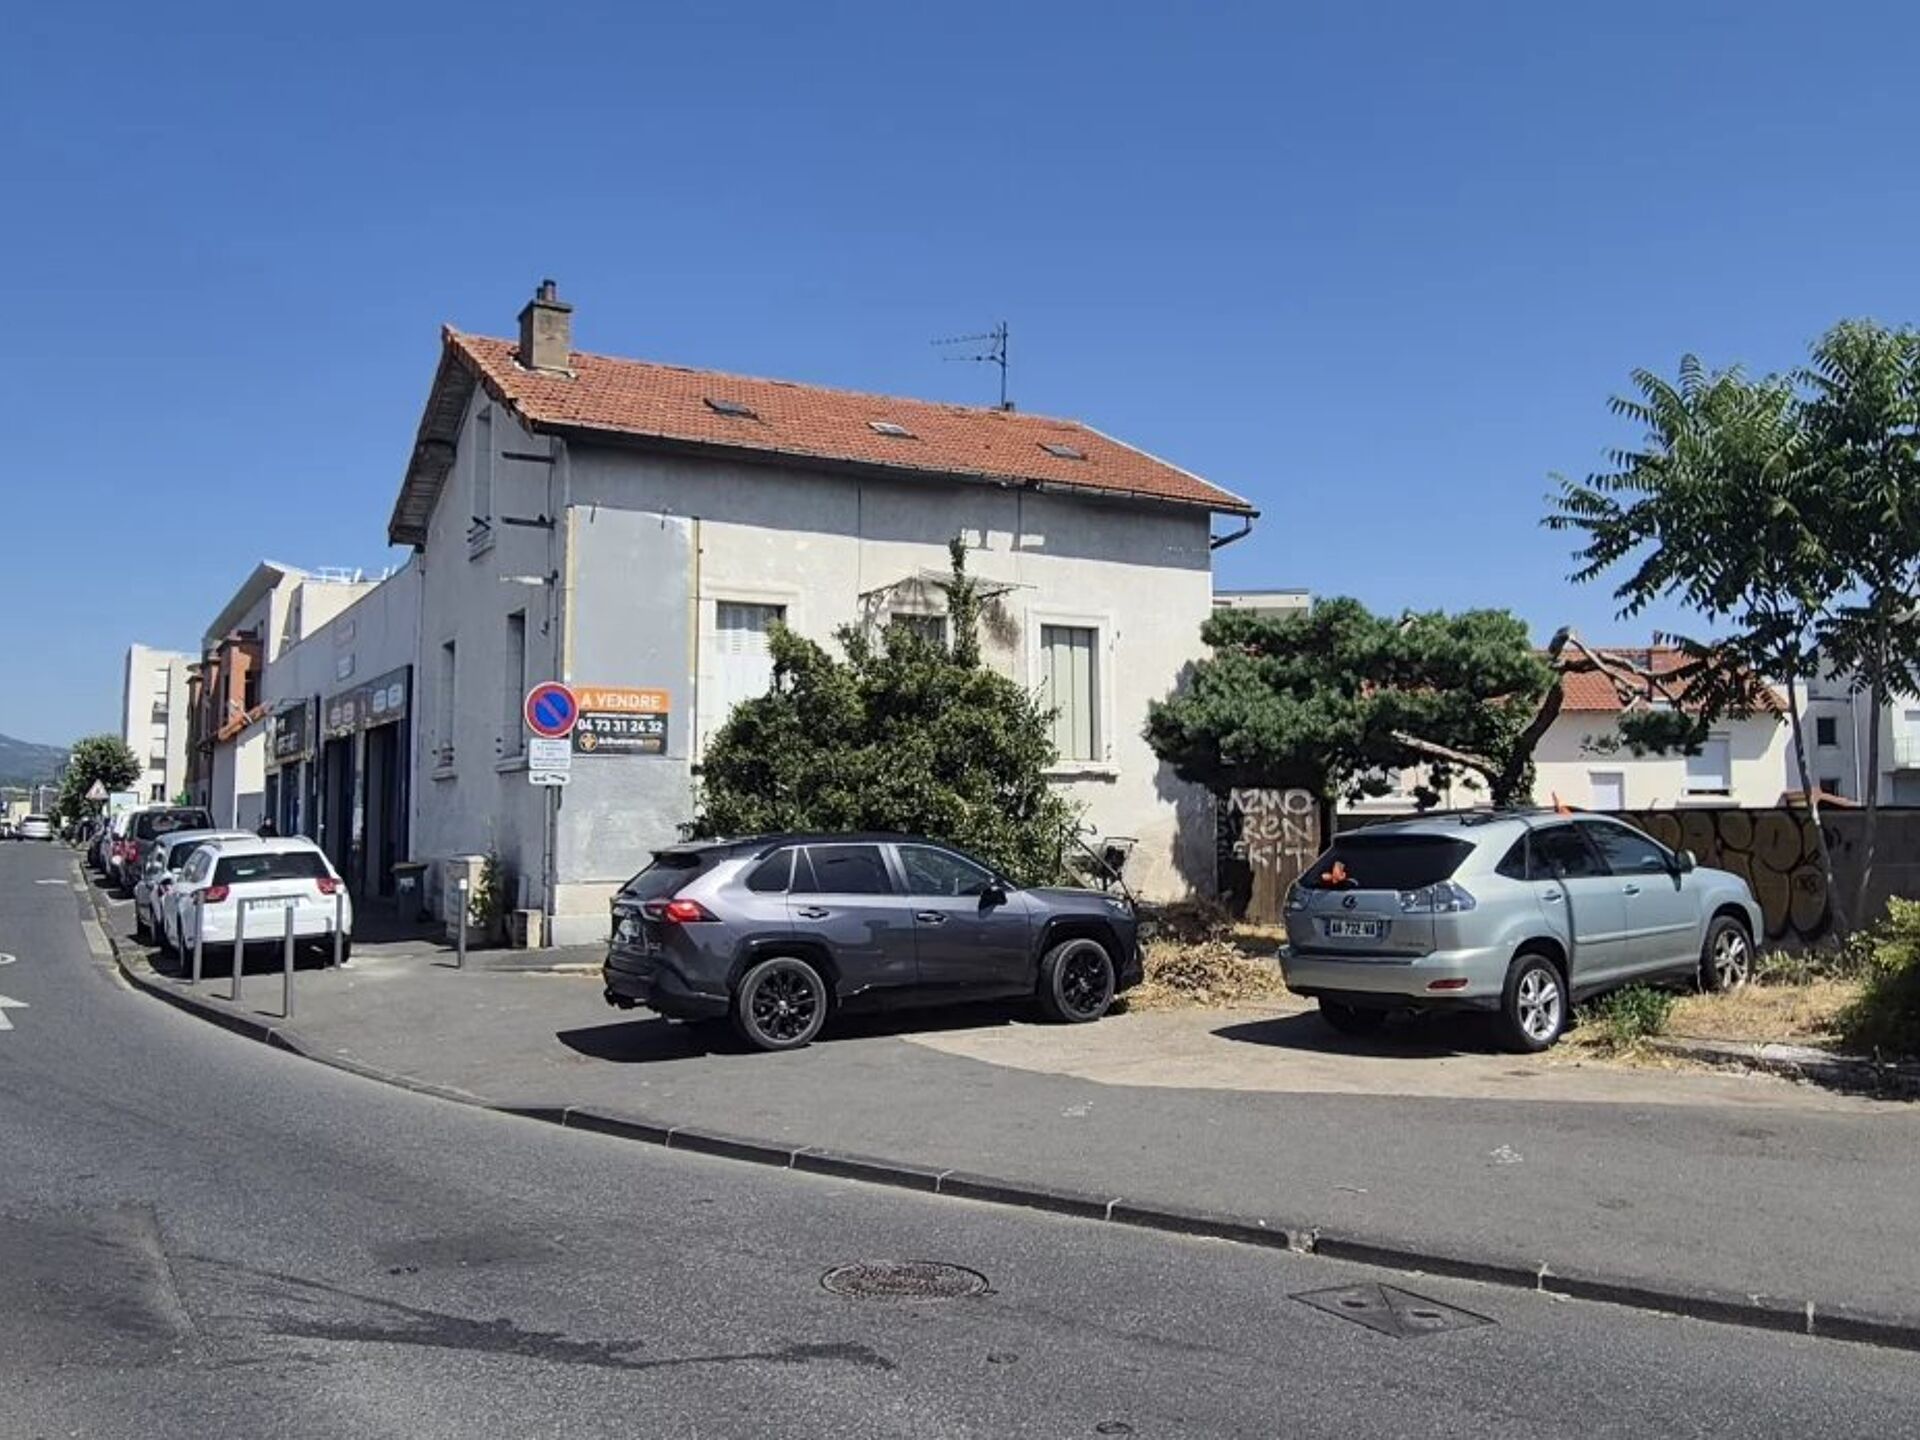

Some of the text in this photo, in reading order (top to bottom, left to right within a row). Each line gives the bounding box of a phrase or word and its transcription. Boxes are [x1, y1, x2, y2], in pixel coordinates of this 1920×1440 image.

[581, 693, 661, 708] A VENDRE
[577, 720, 593, 731] 04
[596, 720, 611, 732] 73
[613, 720, 627, 732] 31
